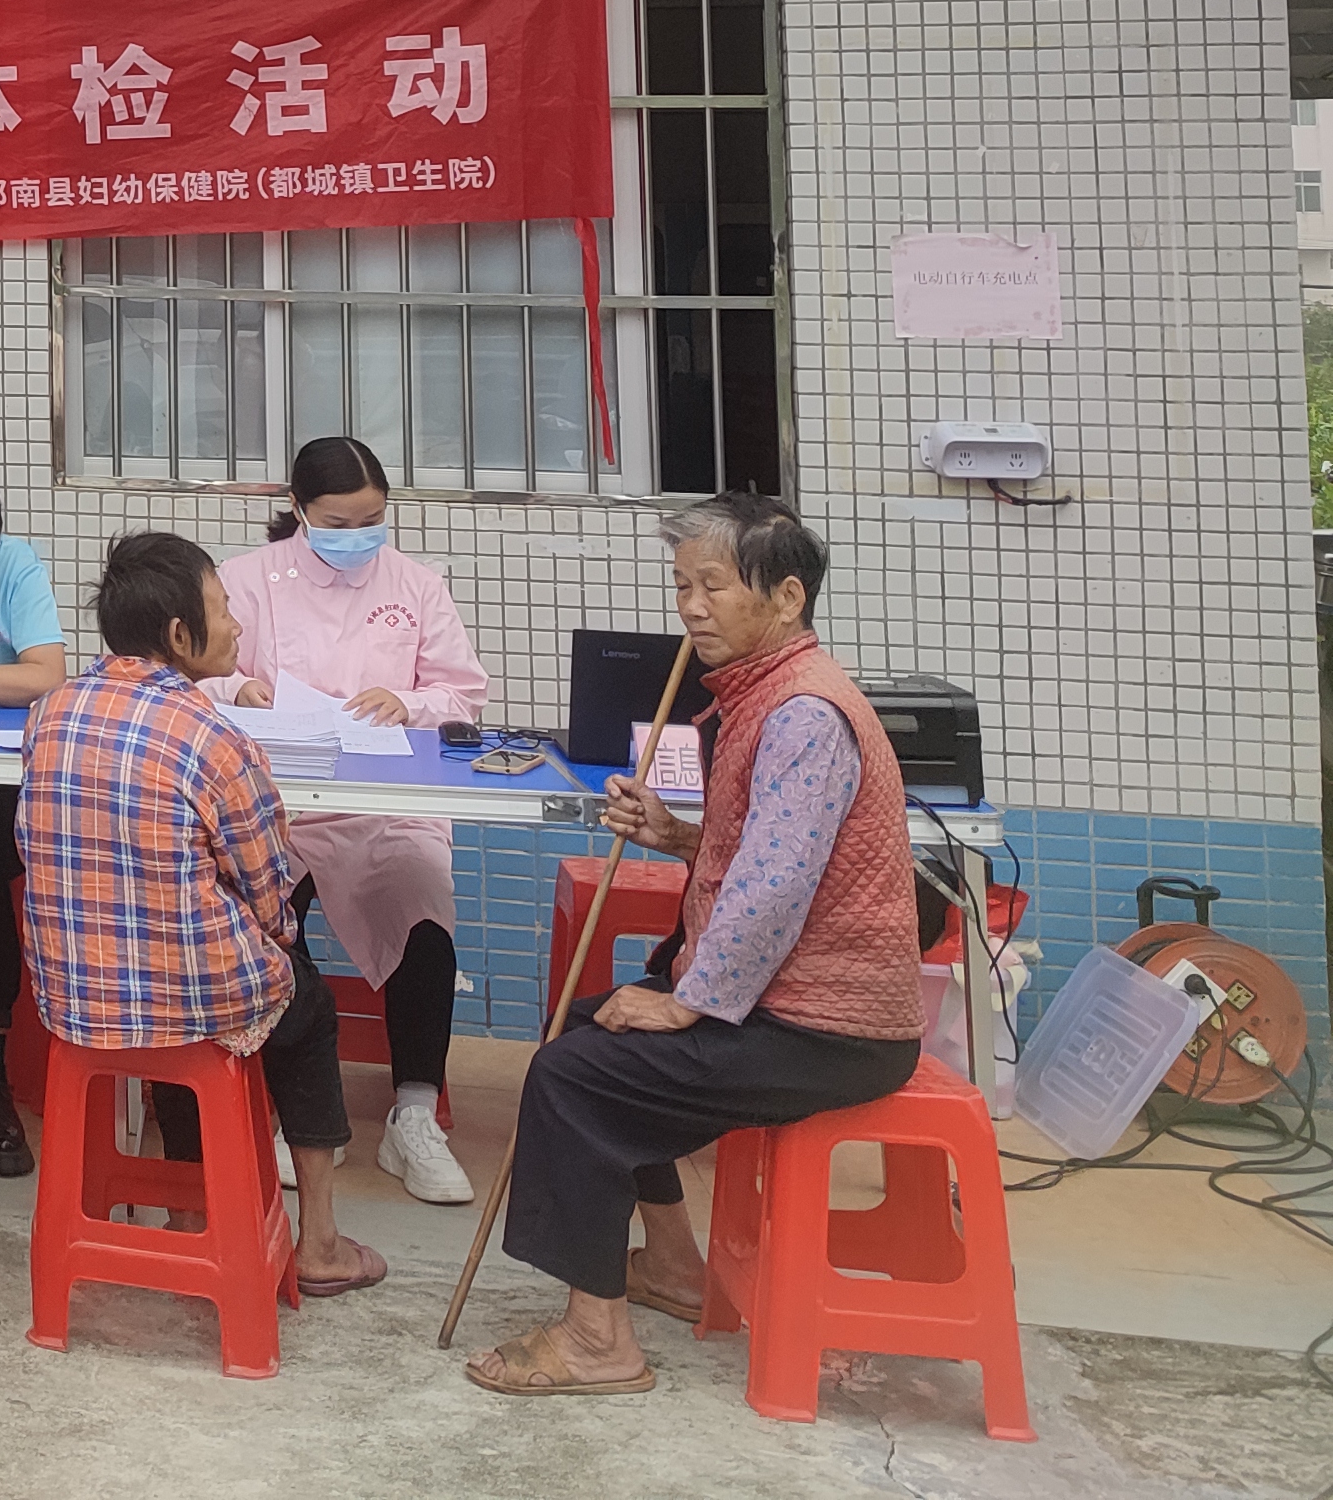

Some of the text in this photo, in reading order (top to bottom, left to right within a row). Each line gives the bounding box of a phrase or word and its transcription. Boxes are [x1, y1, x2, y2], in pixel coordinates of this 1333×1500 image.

[913, 270, 1039, 287] 电动自行车充电点
[601, 649, 641, 660] Lenovo
[653, 742, 700, 787] 信息
